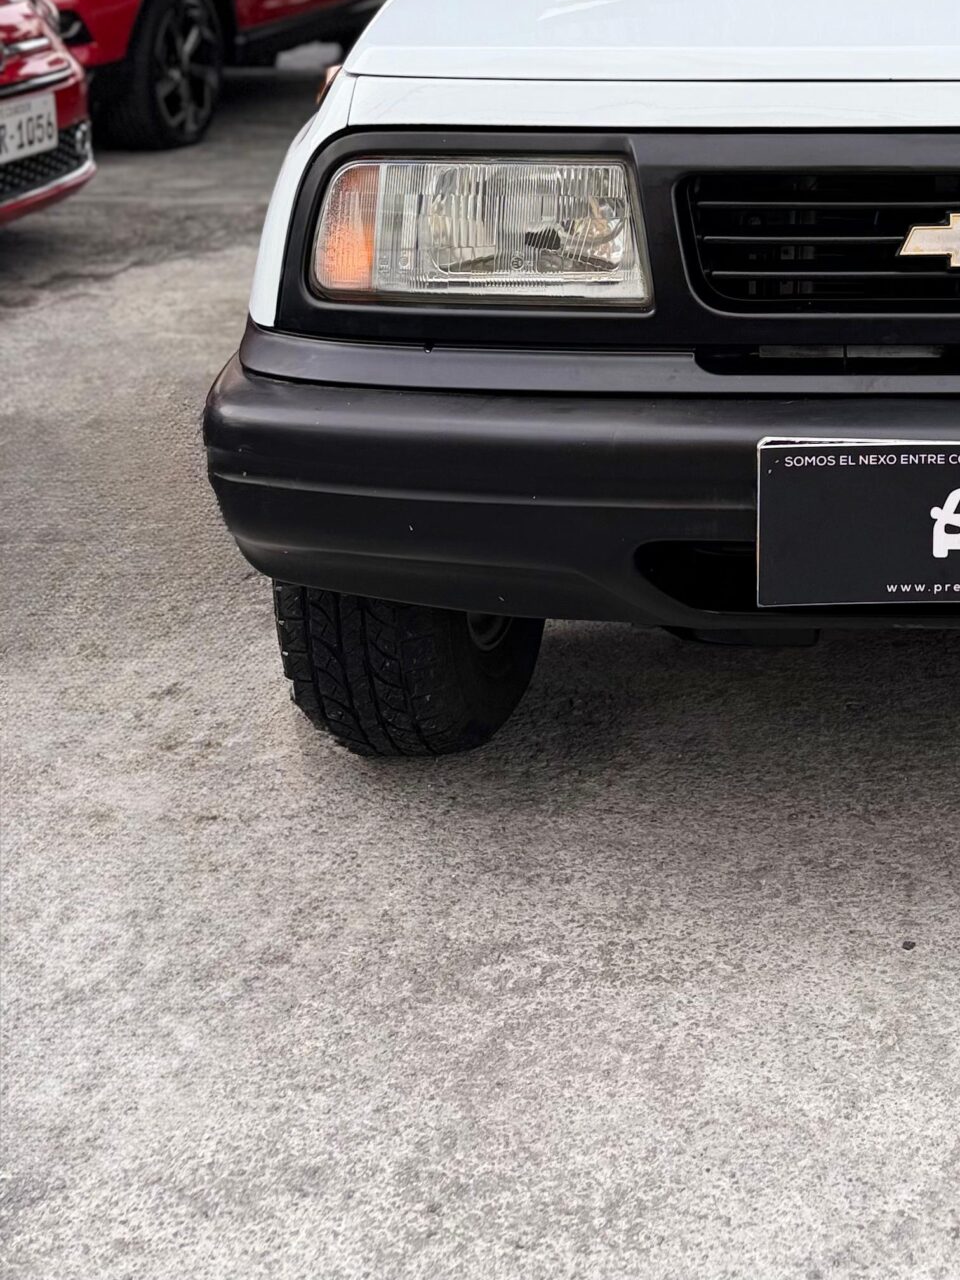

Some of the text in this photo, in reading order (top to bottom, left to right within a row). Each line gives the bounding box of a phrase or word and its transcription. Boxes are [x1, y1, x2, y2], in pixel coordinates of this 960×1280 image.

[784, 454, 836, 467] SOMOS
[839, 454, 856, 466] EL
[858, 453, 897, 466] NEXO
[900, 453, 946, 466] ENTRE
